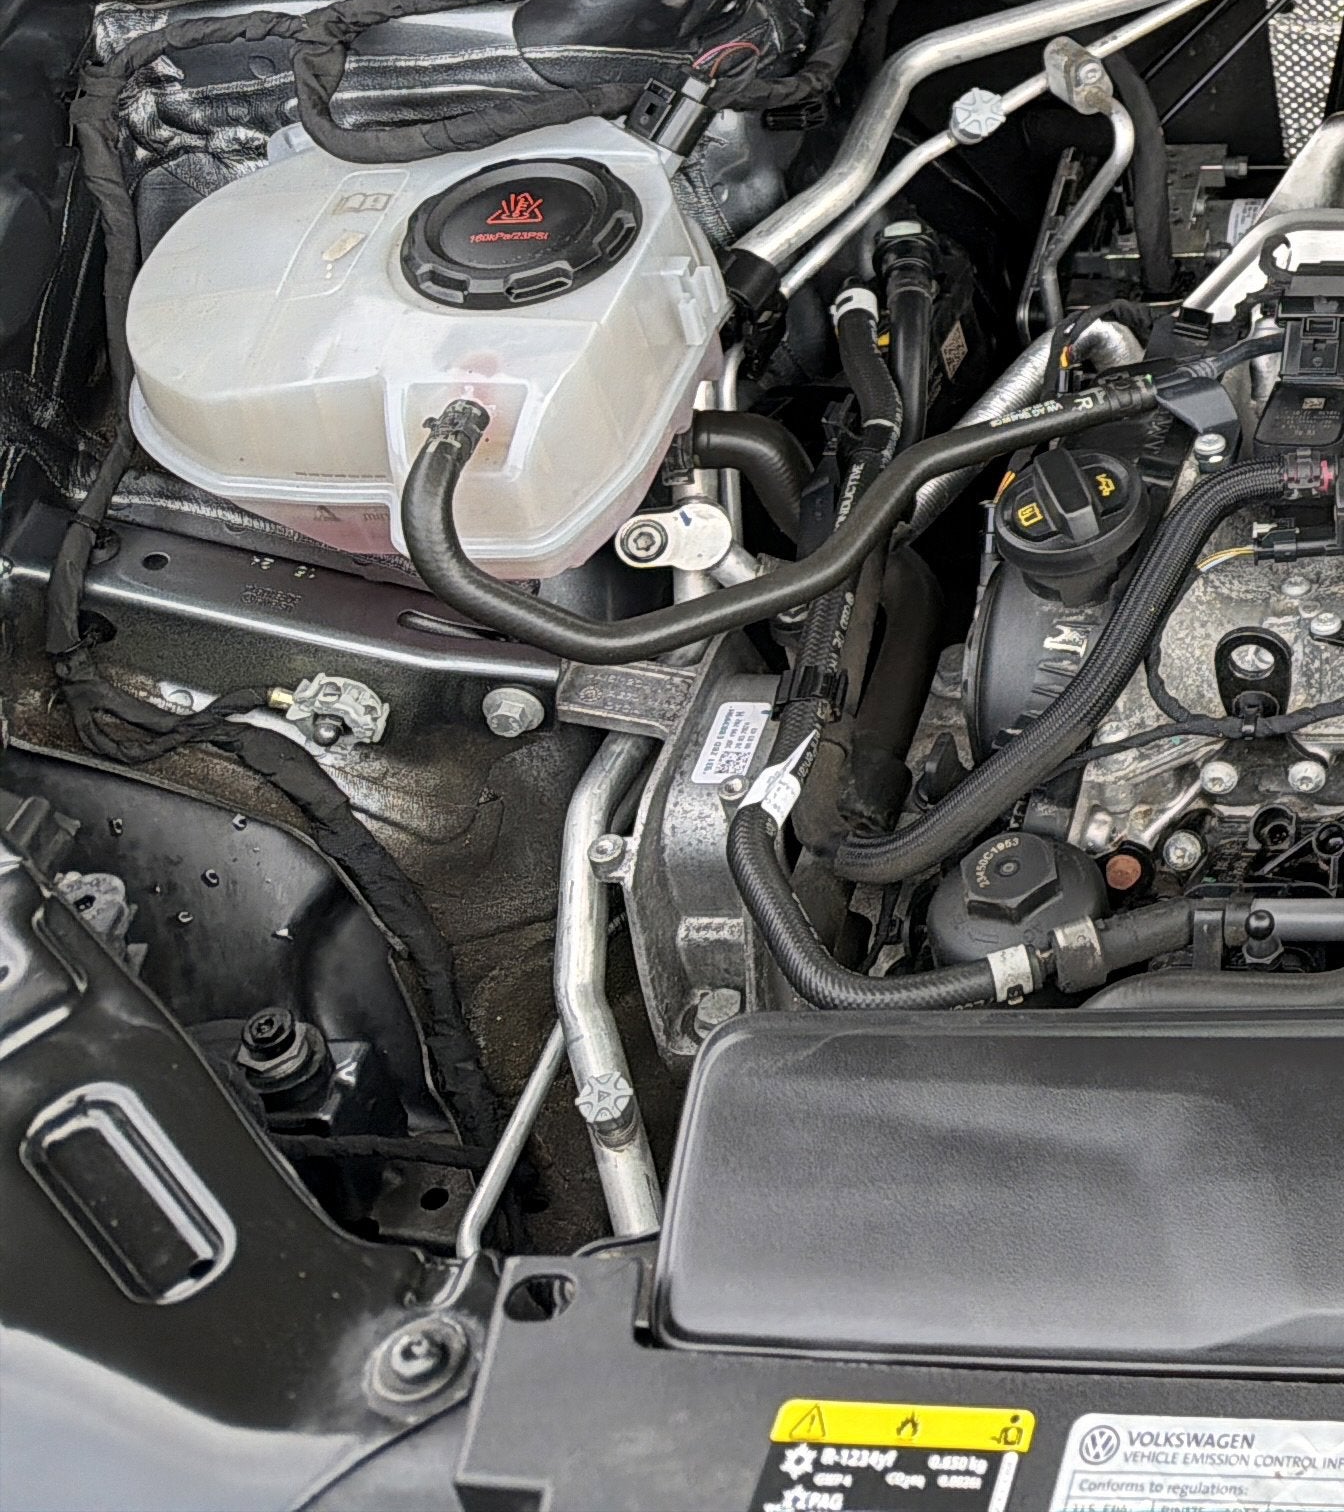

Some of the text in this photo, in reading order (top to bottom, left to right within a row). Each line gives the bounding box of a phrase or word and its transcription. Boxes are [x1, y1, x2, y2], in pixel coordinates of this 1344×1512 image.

[1127, 1431, 1256, 1450] VOLKSWAGEN
[820, 1447, 899, 1471] R-1234yf
[1123, 1451, 1179, 1465] VEHICLE
[1182, 1453, 1251, 1467] EMISSION
[1254, 1455, 1319, 1470] CONTROL
[1078, 1478, 1249, 1497] Conforms to regulations:
